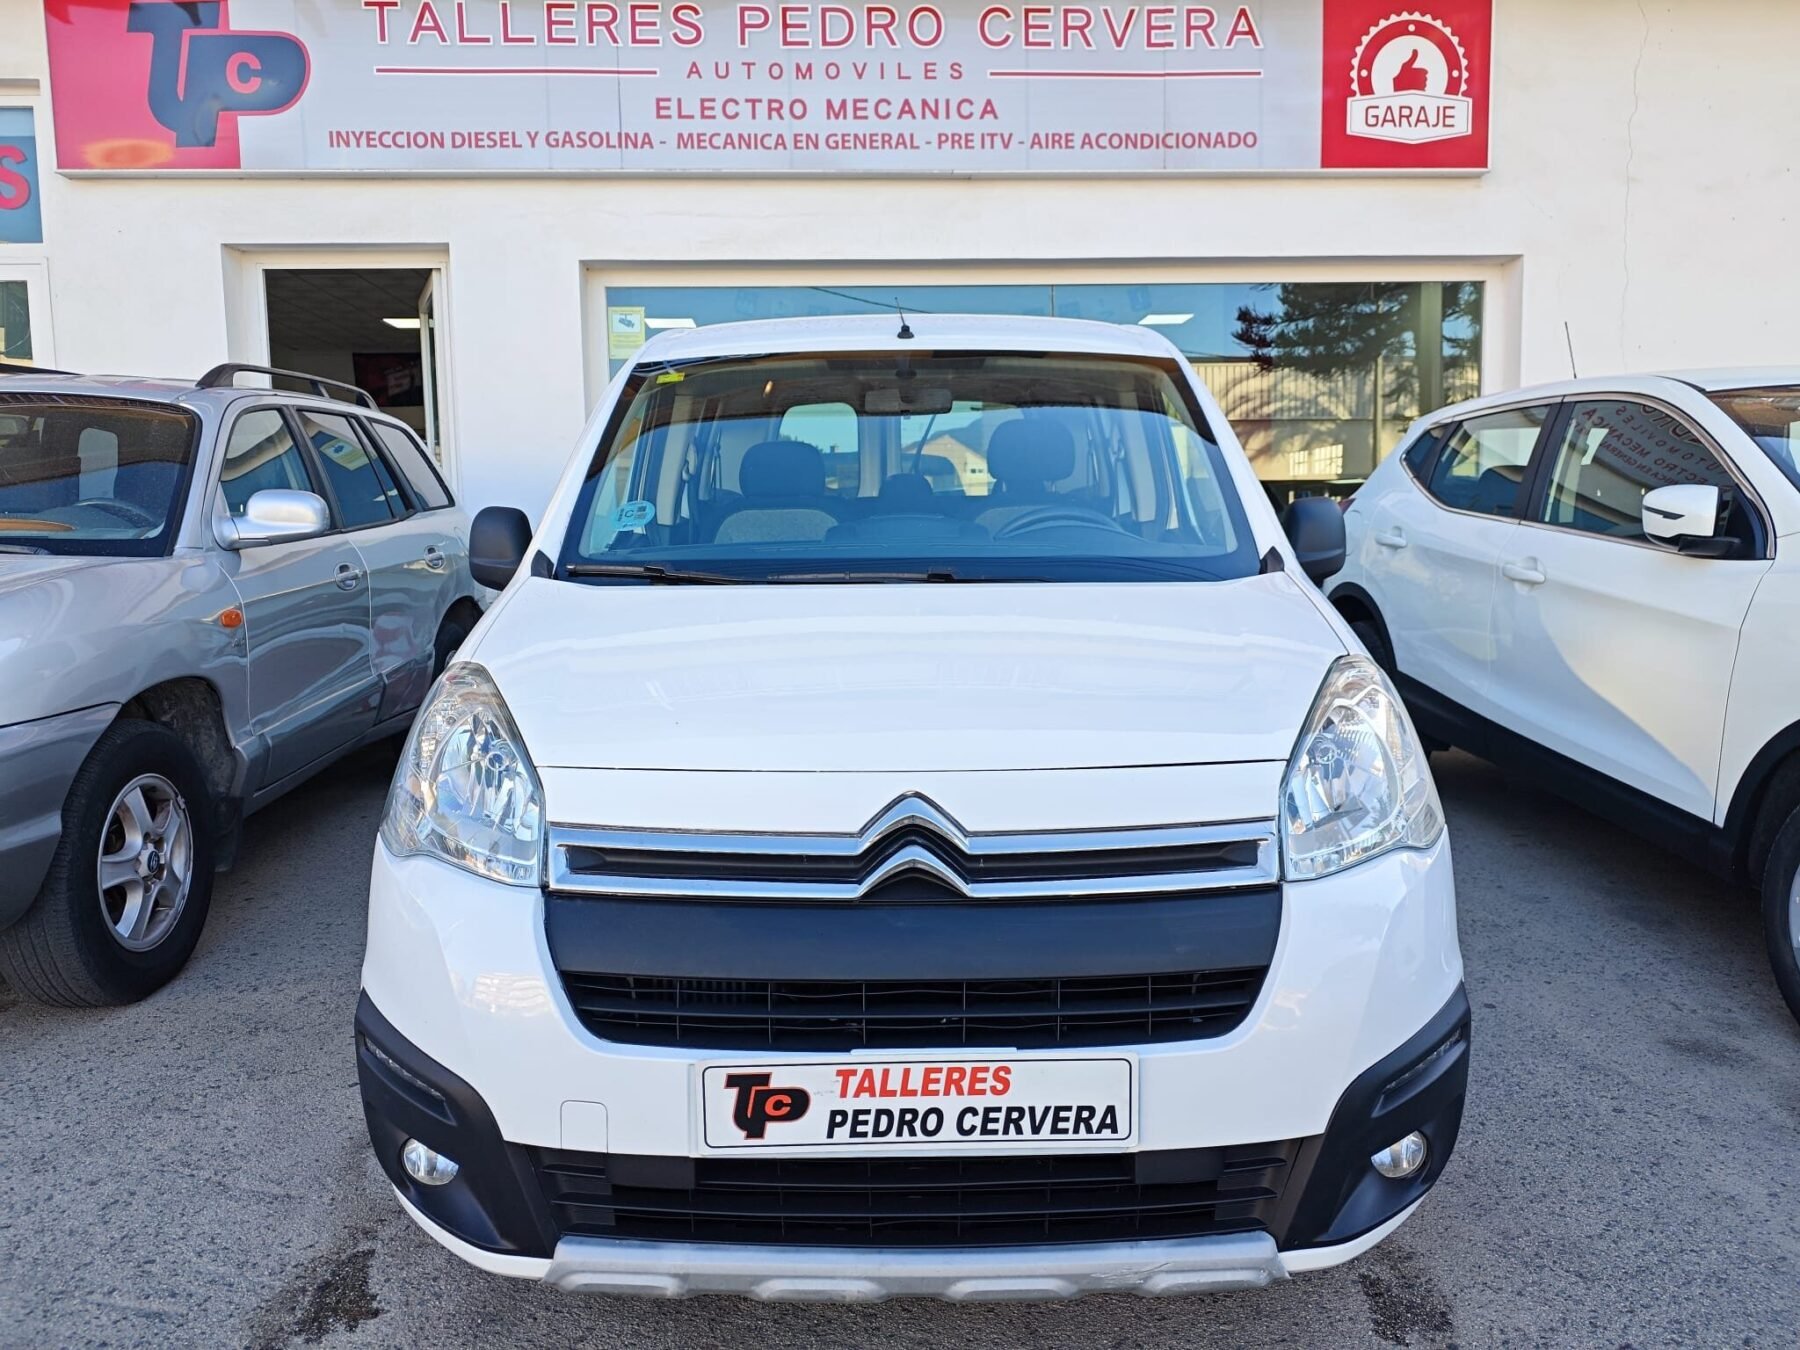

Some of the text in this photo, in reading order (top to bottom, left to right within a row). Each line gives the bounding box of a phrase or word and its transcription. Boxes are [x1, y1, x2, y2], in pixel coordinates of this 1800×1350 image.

[363, 0, 1263, 50] TALLERES PEDRO CERVERA
[686, 61, 965, 81] AUTOMOVILES
[655, 98, 1000, 120] ELECTRO MECANICA
[1364, 105, 1456, 129] GARAJE
[328, 130, 446, 150] INYECCION
[450, 131, 522, 149] DIESEL
[525, 131, 541, 149] Y
[545, 131, 654, 150] GASOLINA
[676, 132, 788, 151] MECANICA
[793, 133, 820, 151] EN
[825, 132, 921, 151] GENERAL
[937, 132, 976, 151] PRE
[980, 132, 1013, 150] ITV
[1030, 132, 1076, 150] AIRE
[1080, 131, 1258, 150] ACONDICIONADO
[835, 1066, 1012, 1098] TALLERES
[826, 1105, 1119, 1139] PEDRO CERVERA
